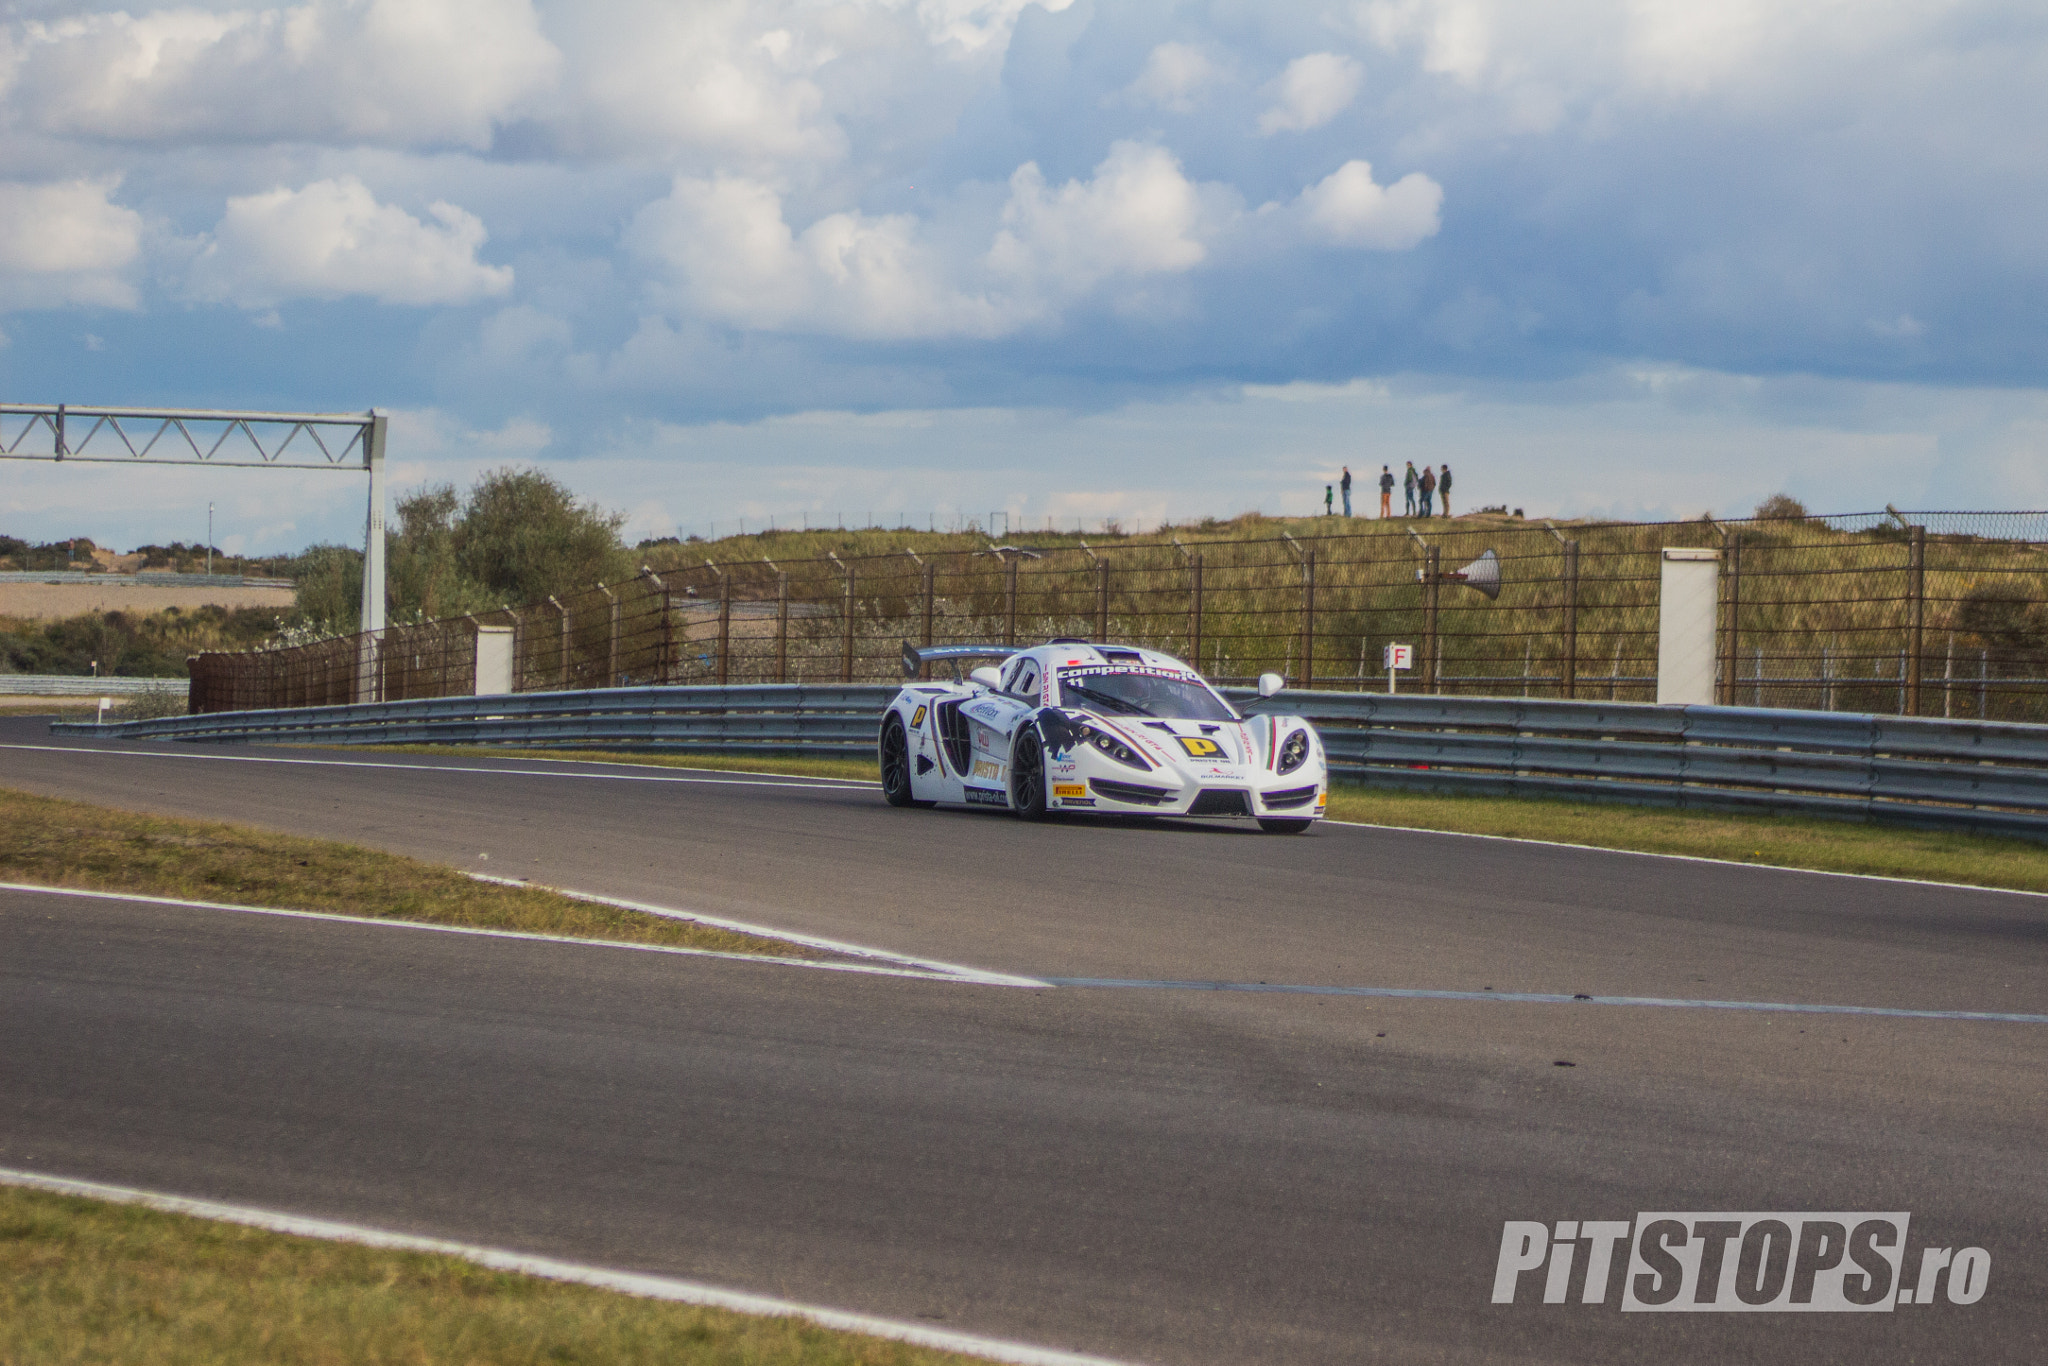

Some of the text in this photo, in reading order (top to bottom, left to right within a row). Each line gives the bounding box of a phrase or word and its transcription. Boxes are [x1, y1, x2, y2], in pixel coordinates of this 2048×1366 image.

[1394, 648, 1406, 665] F
[1067, 677, 1084, 687] 11
[1180, 737, 1218, 756] P
[1055, 786, 1082, 795] PIRELLI
